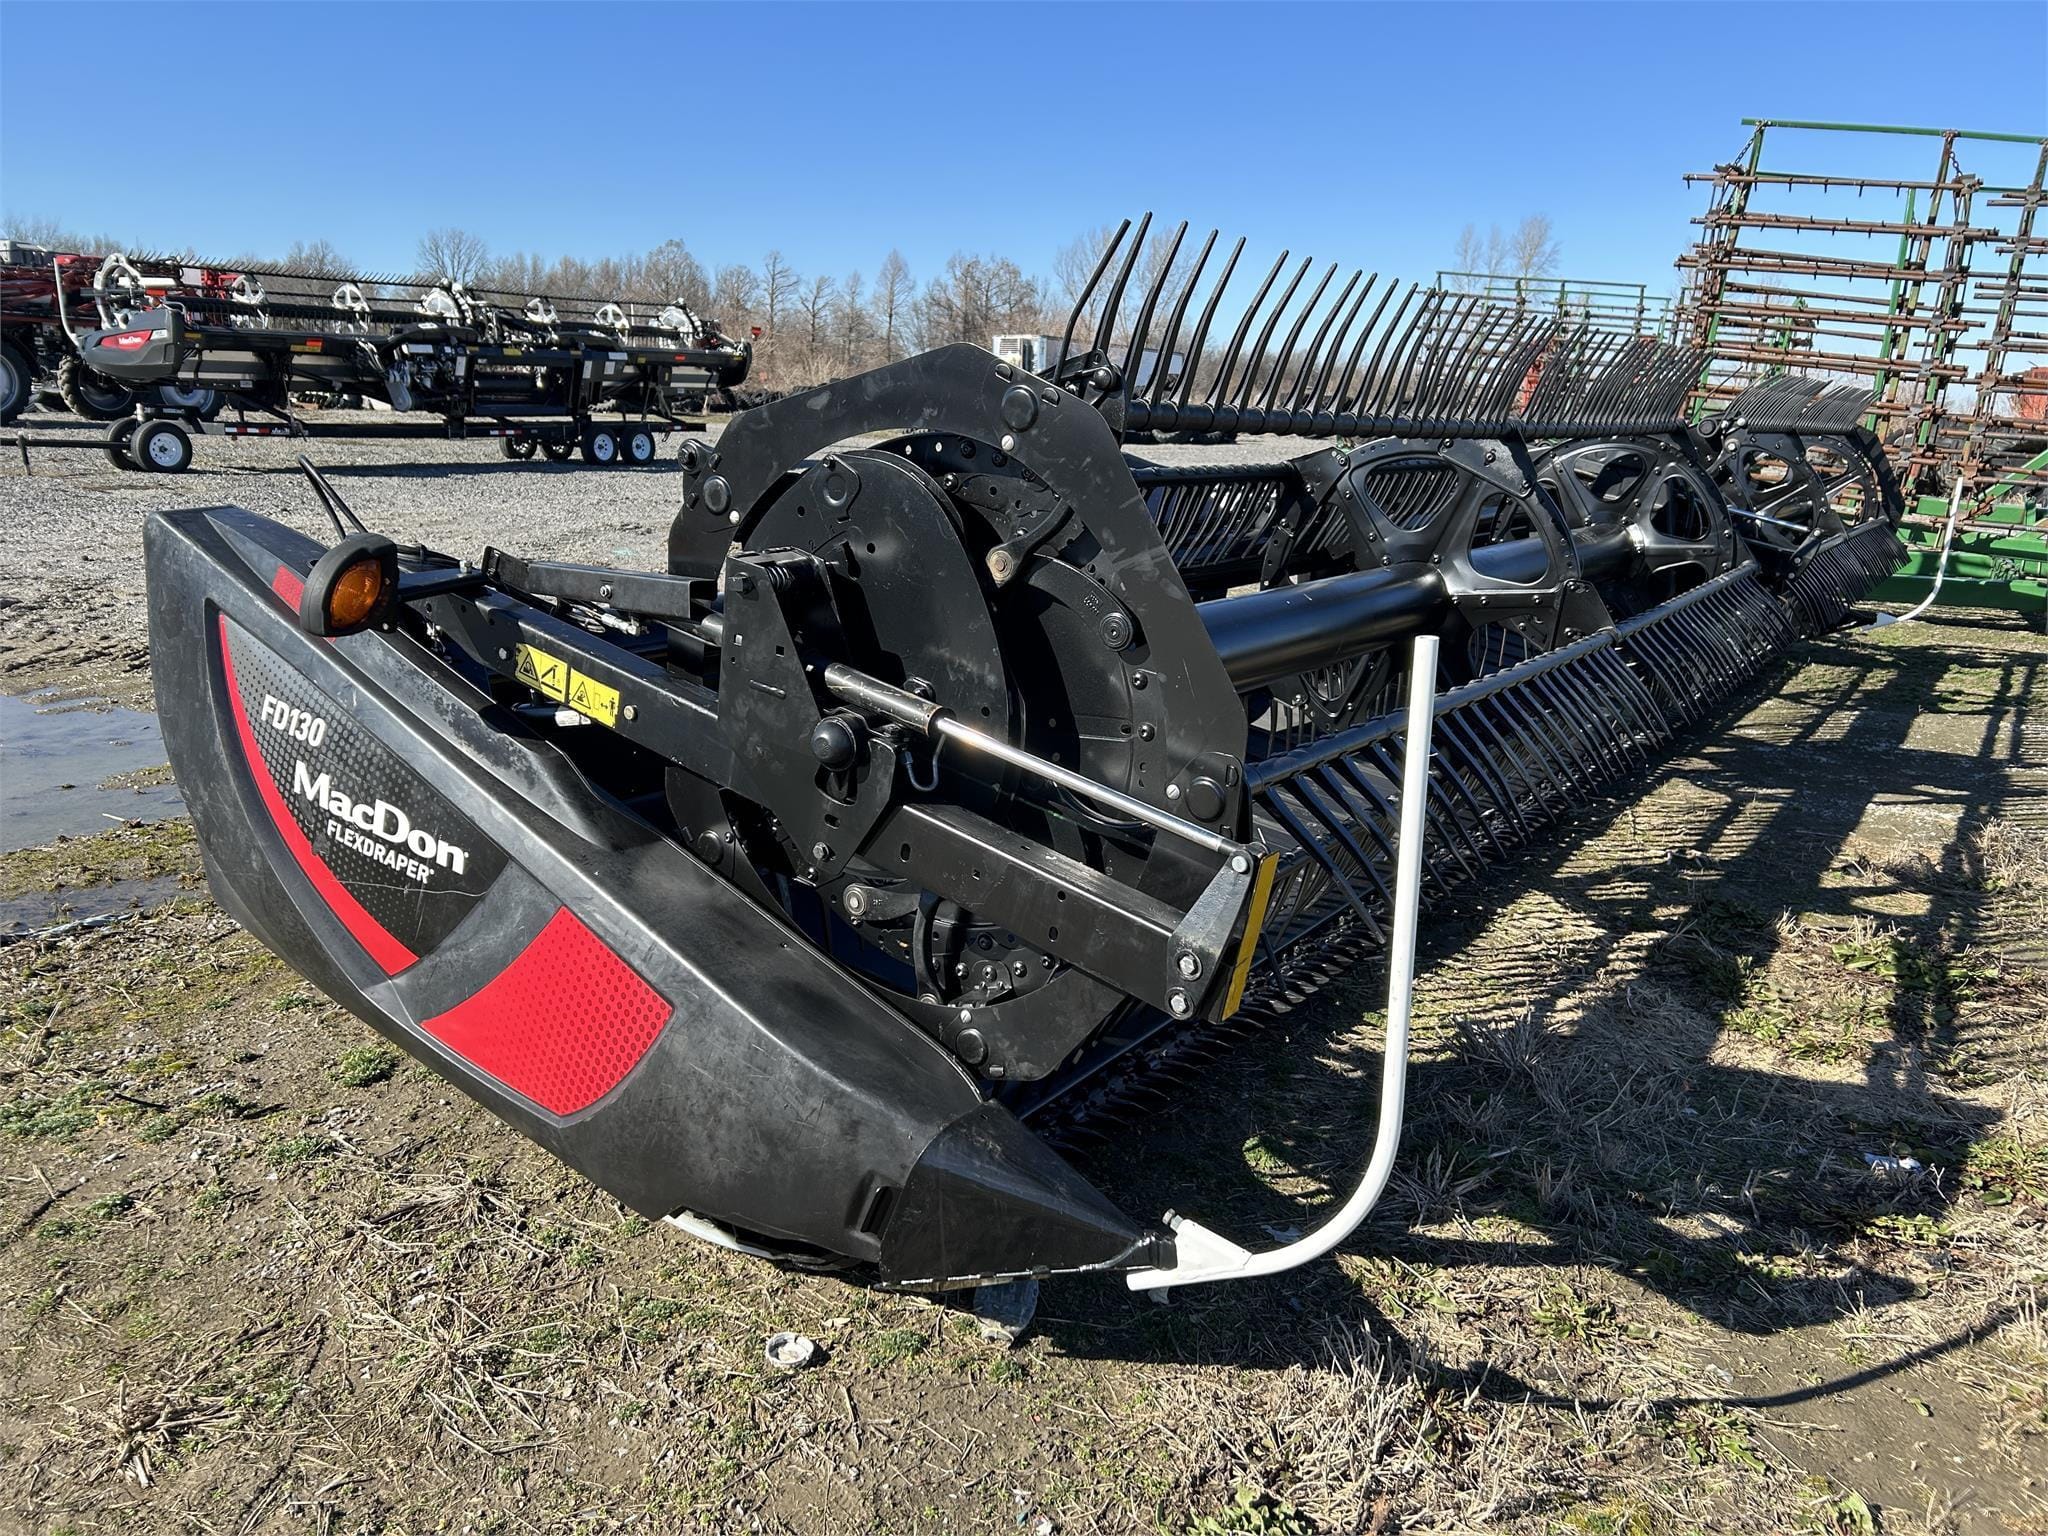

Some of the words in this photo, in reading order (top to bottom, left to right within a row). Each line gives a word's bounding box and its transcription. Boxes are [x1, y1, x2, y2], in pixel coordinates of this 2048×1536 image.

[261, 694, 326, 747] FD130
[293, 760, 466, 875] MacDon
[327, 820, 431, 884] FLEXDRAPER
